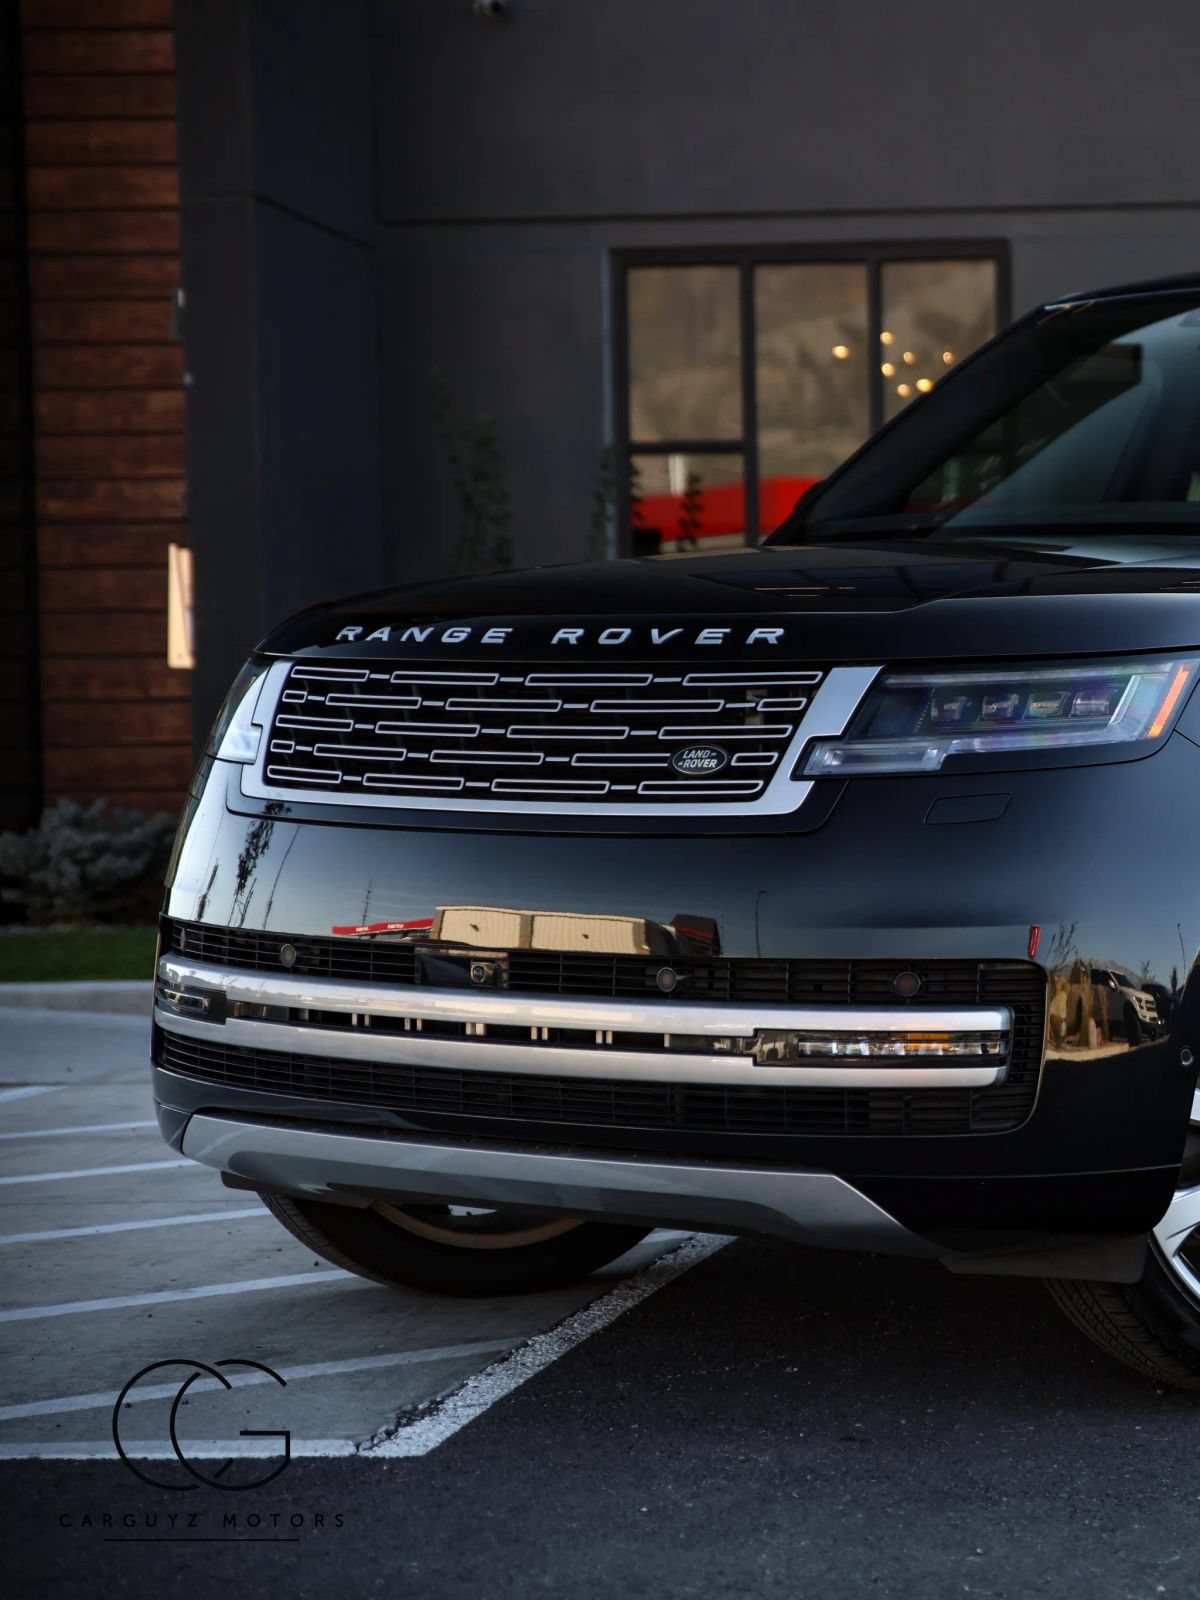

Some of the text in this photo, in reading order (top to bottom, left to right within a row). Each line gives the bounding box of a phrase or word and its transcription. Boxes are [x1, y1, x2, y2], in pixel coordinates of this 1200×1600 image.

[335, 625, 787, 645] RANGE ROVER
[682, 749, 712, 759] LAND
[682, 758, 718, 769] ROVER
